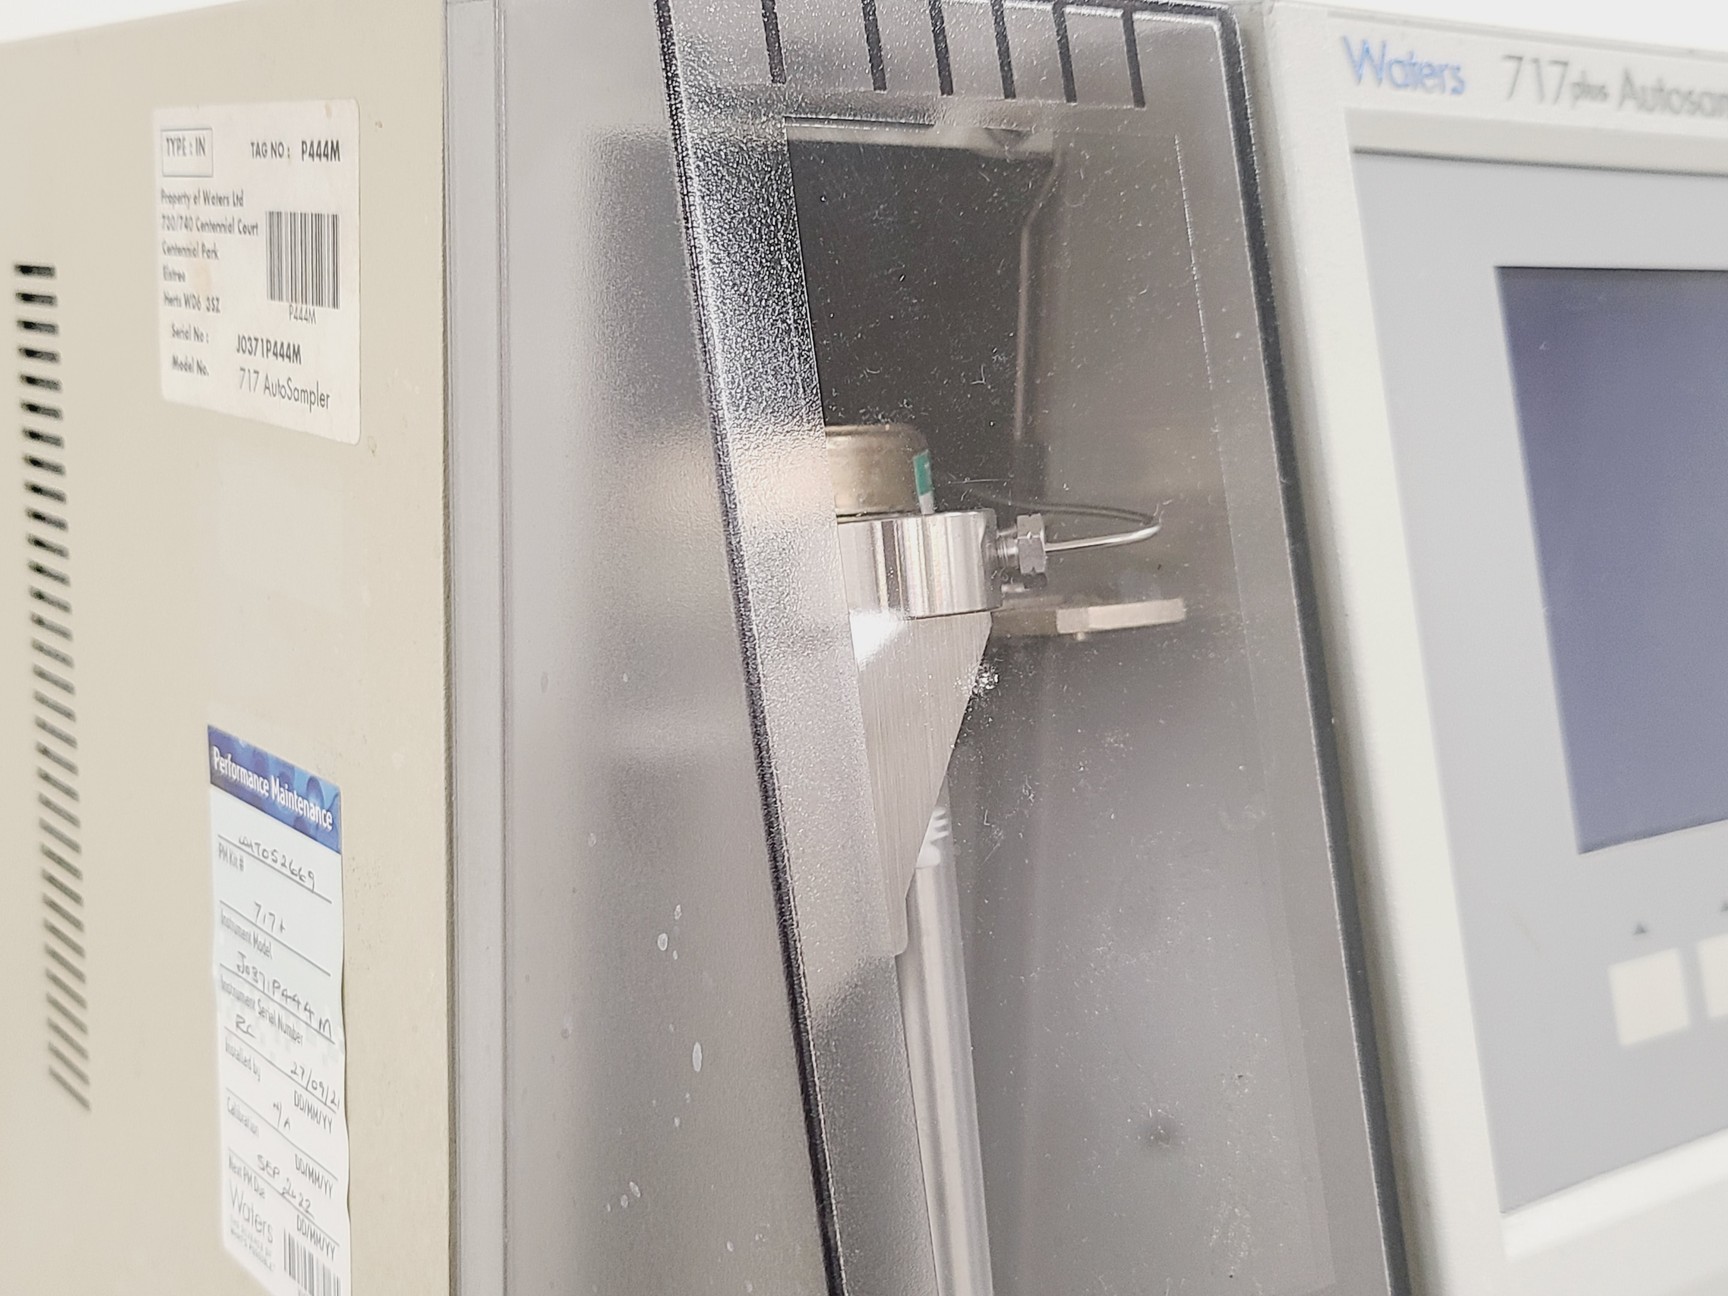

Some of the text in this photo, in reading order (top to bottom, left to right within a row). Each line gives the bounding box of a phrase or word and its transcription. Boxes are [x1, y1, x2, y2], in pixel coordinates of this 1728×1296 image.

[1341, 34, 1466, 97] Waters
[166, 137, 187, 157] TYPE
[195, 136, 206, 156] IN
[250, 141, 268, 159] TAG
[271, 141, 285, 158] NO
[301, 139, 341, 162] P444M
[161, 189, 244, 209] Property of Waters Ltd
[196, 216, 235, 235] Centennial
[237, 219, 259, 236] Court
[162, 240, 220, 260] Centennial Park
[164, 291, 182, 308] Herts
[289, 303, 317, 325] P444M
[172, 323, 192, 341] Serial
[236, 333, 302, 365] J0371P444M
[172, 354, 210, 377] Model No.
[240, 367, 331, 413] 717 AutoSampler
[213, 745, 333, 831] Performance Maintenance
[278, 1013, 304, 1046] Number
[294, 1089, 333, 1134] DD/MM/YY
[295, 1153, 334, 1199] DD/MM/YY
[229, 1178, 274, 1244] Waters
[297, 1214, 336, 1261] DD/MM/YY
